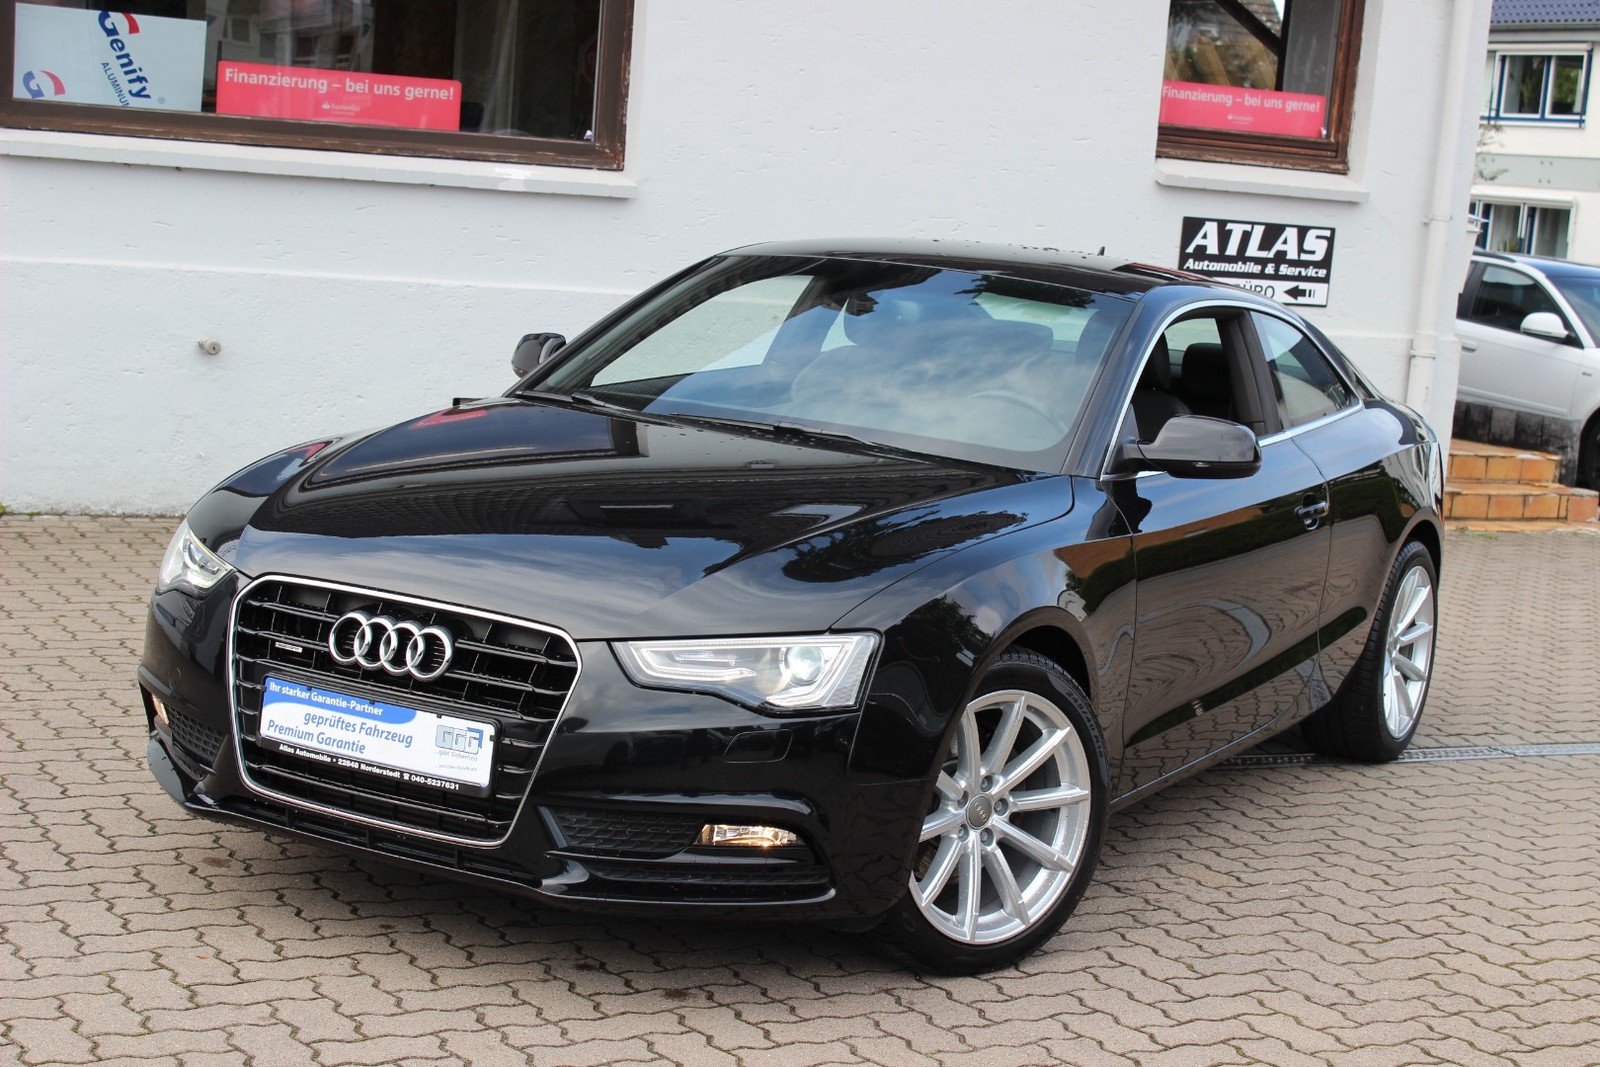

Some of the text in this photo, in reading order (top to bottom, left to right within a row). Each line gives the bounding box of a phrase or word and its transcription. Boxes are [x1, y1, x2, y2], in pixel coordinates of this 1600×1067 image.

[98, 10, 152, 100] Genify
[225, 67, 328, 94] Finanzierung
[345, 78, 369, 94] bei
[374, 83, 400, 97] uns
[405, 86, 454, 101] gerne!
[1163, 86, 1232, 107] Finanzierung
[1244, 93, 1260, 107] bei
[1264, 99, 1282, 109] uns
[1285, 100, 1320, 113] gerne!
[1185, 220, 1332, 262] ATLAS
[1184, 258, 1327, 278] Automobile & Service
[269, 681, 384, 716] Ihr starker Garantie-Partner
[267, 719, 366, 754] Premium Garantie
[303, 711, 413, 748] geprüftes Fahrzeug
[295, 748, 332, 763] Automobile
[360, 763, 401, 779] Norderstedt
[411, 775, 460, 791] 040-5237631
